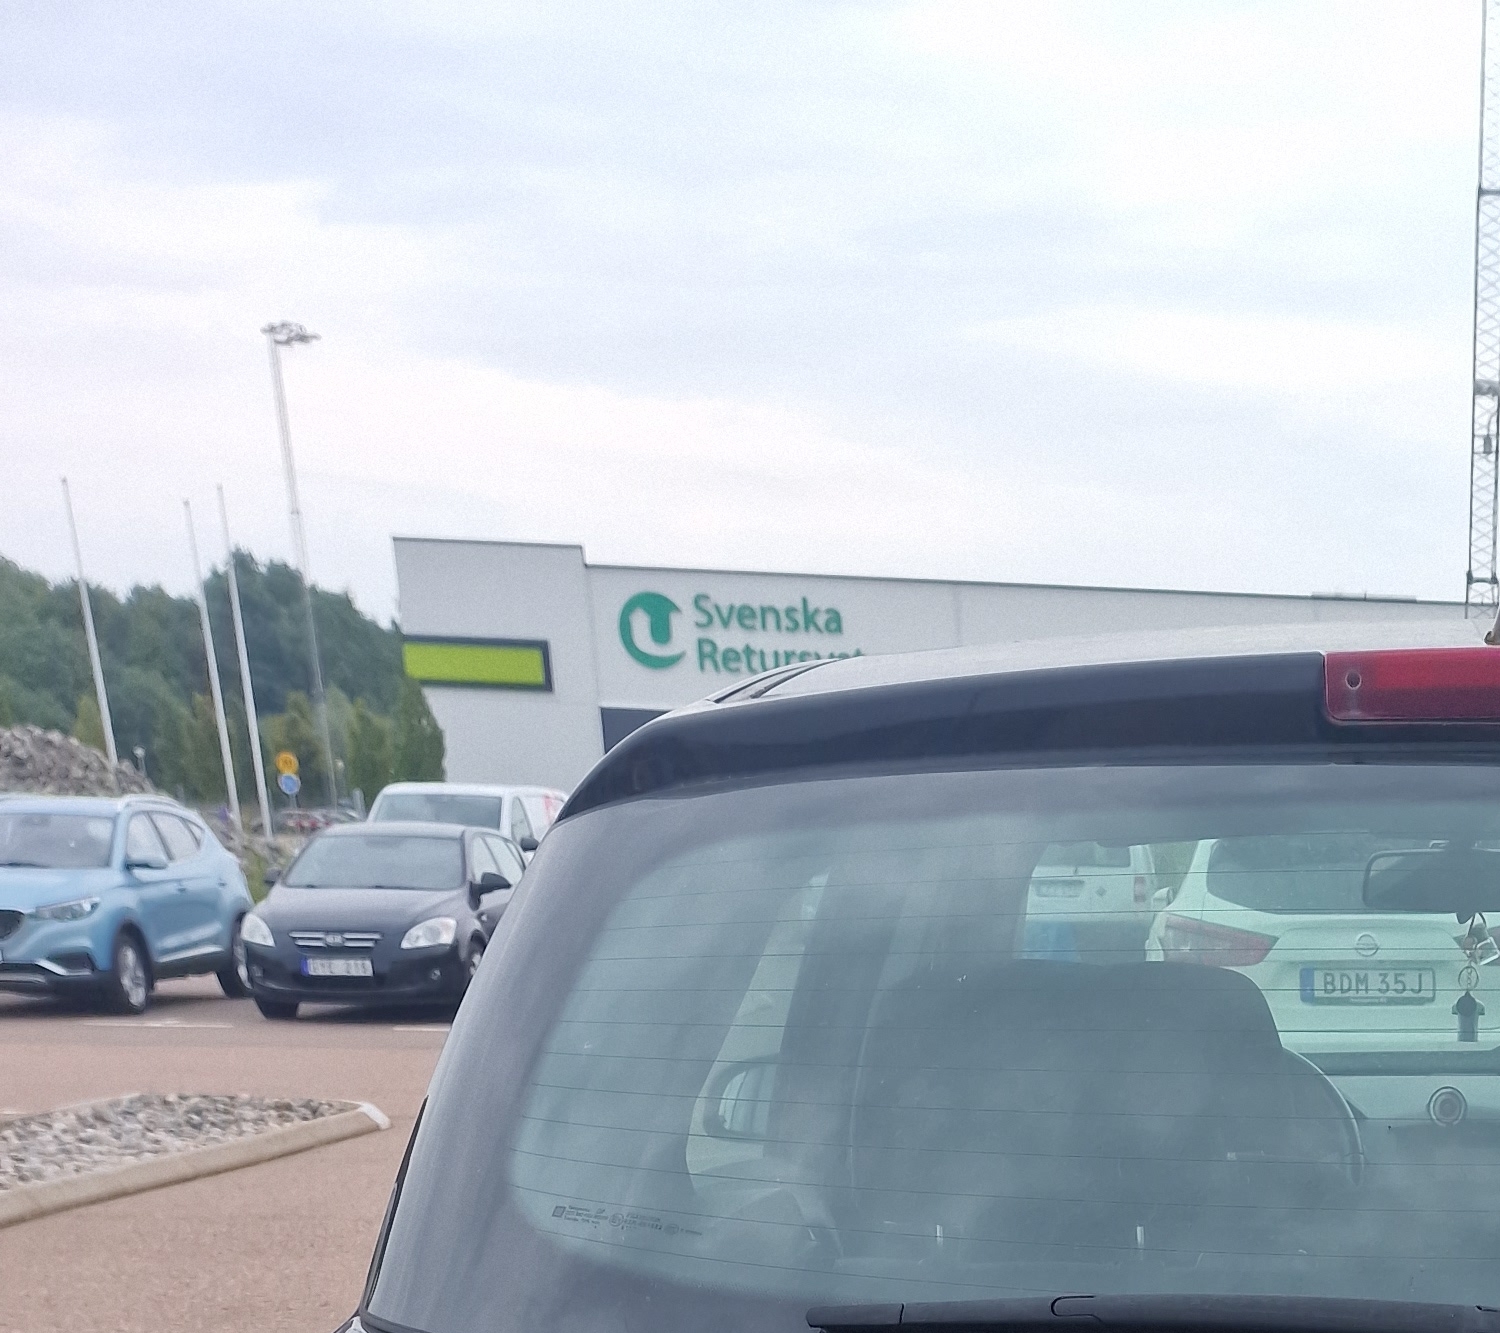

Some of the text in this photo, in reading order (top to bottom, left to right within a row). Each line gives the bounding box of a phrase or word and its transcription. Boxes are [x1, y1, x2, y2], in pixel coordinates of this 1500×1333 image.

[694, 594, 843, 634] Svenska
[1323, 972, 1423, 995] BDM 35J
